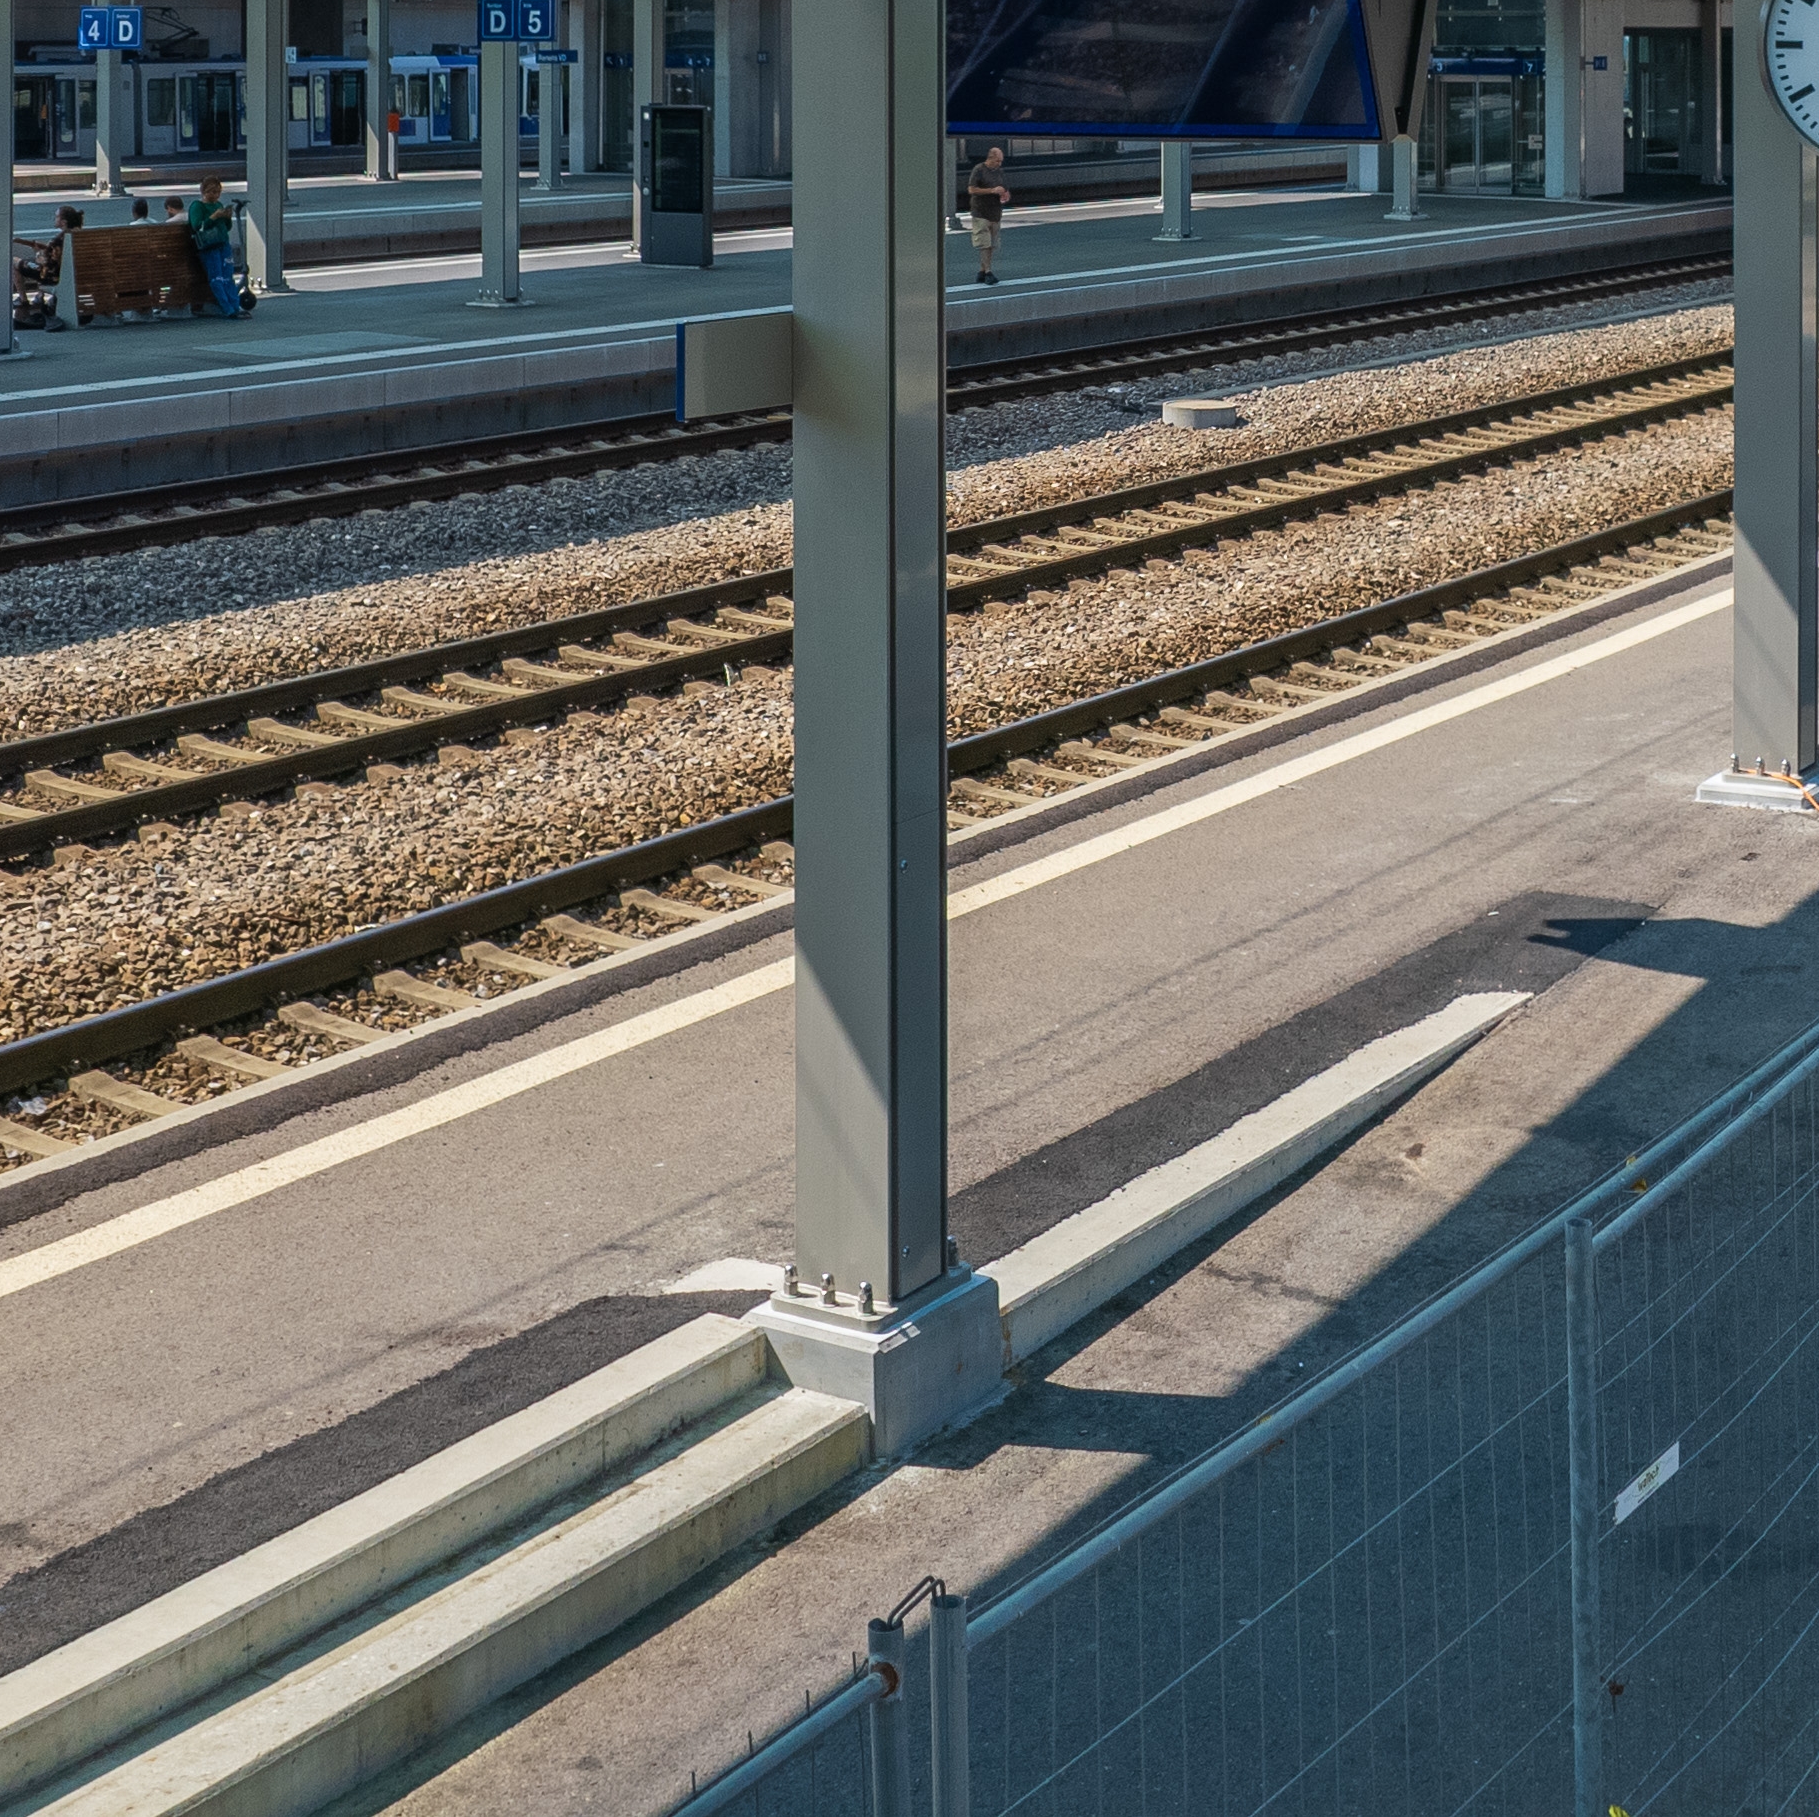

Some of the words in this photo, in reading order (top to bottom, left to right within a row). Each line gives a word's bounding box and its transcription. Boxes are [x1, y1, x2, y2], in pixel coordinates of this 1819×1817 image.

[88, 20, 100, 42] 4
[119, 20, 133, 42] D
[490, 10, 506, 33] D
[528, 10, 542, 34] 5
